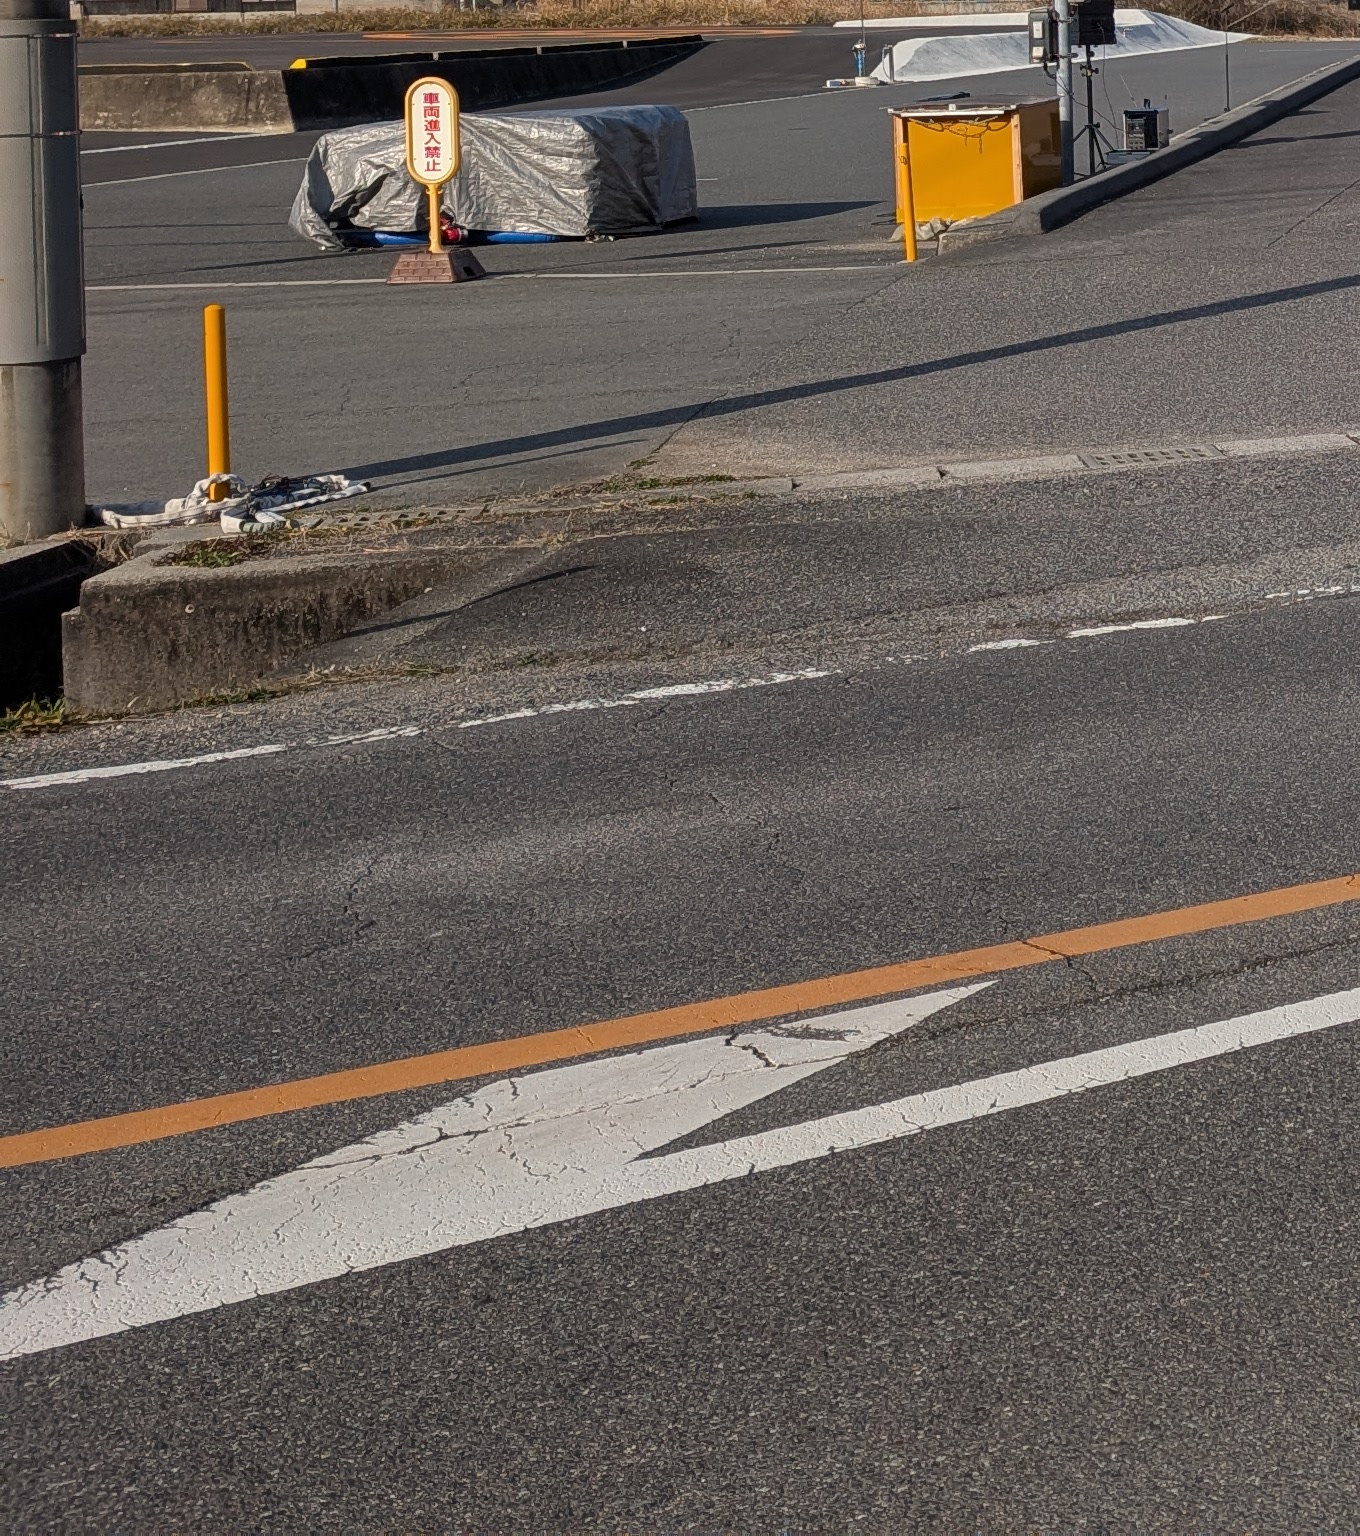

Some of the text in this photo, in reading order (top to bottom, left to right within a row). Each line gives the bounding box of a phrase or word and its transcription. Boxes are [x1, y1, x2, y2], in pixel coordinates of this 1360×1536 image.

[423, 92, 441, 172] 車両進入禁止
